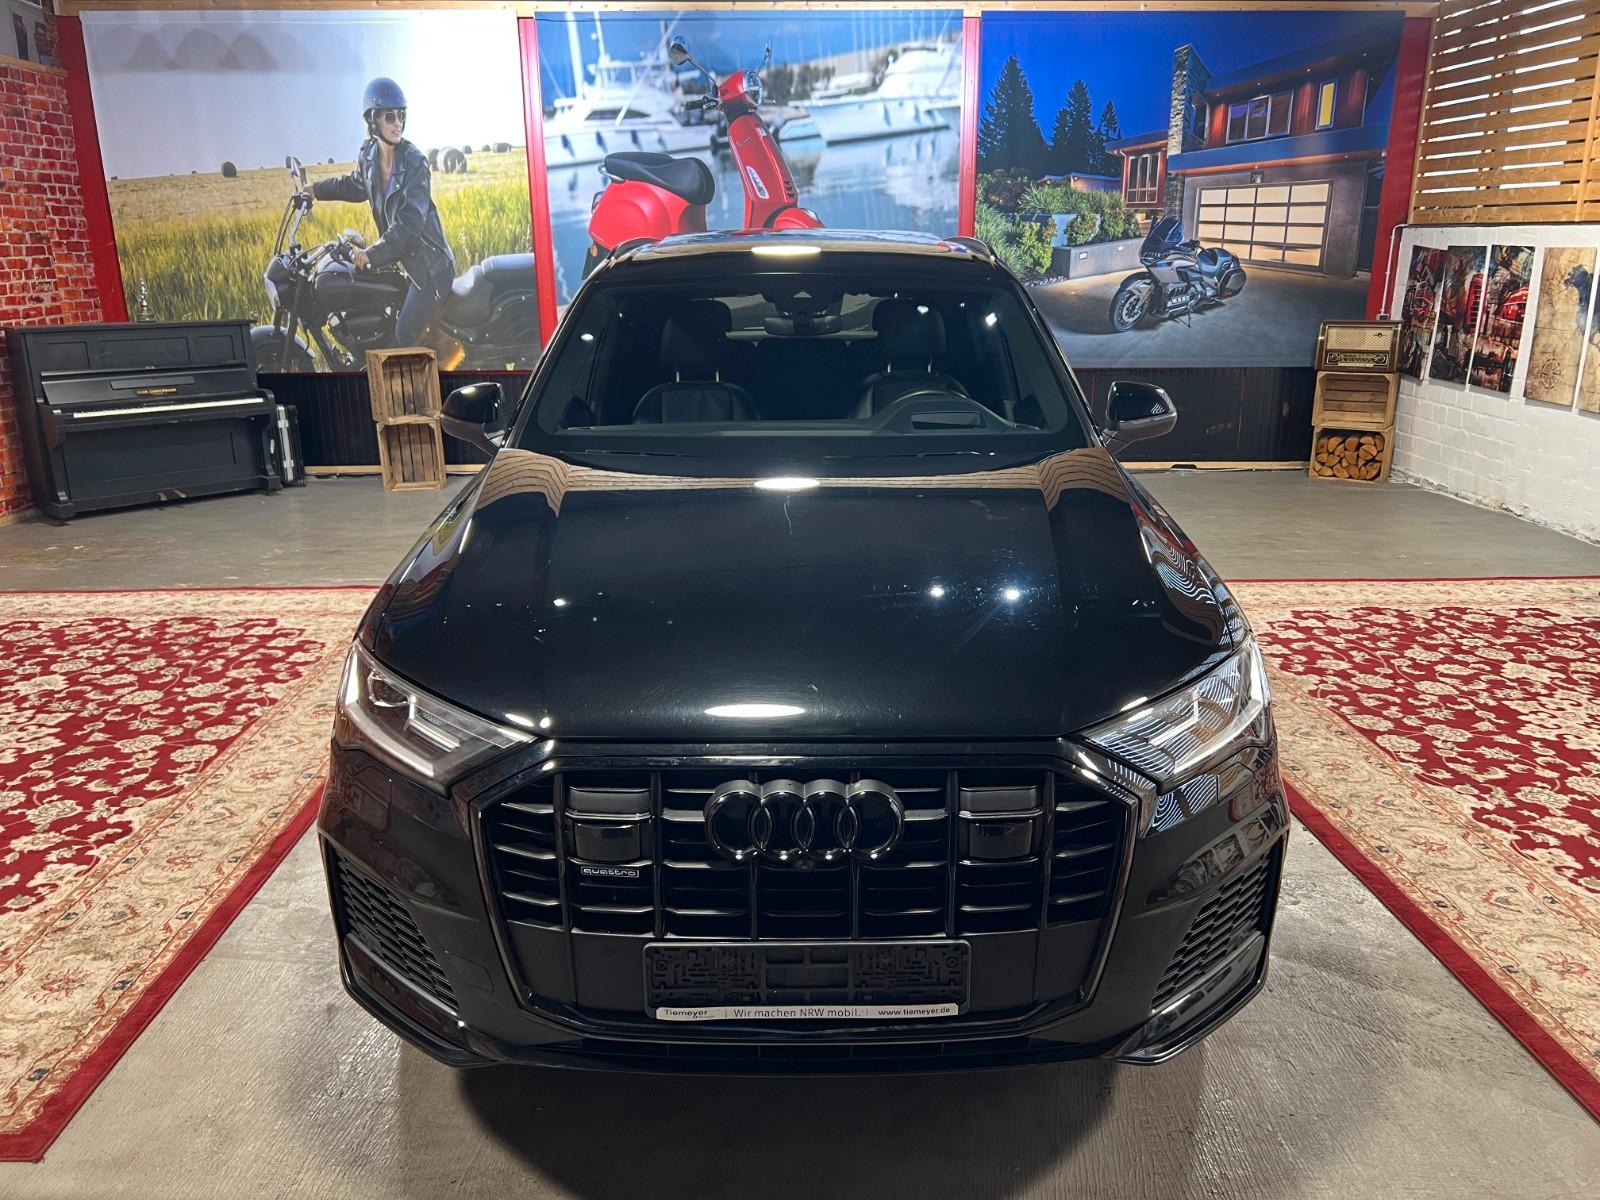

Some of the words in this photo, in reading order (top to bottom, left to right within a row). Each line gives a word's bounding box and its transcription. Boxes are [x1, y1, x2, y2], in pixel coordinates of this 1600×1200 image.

[583, 868, 636, 876] quattro
[664, 1009, 708, 1019] Tiemeyer
[734, 1008, 751, 1017] Wir
[754, 1008, 796, 1017] machen
[800, 1008, 824, 1017] NRW
[828, 1007, 861, 1017] mobil.
[878, 1006, 951, 1016] www.tiemeyer.de
